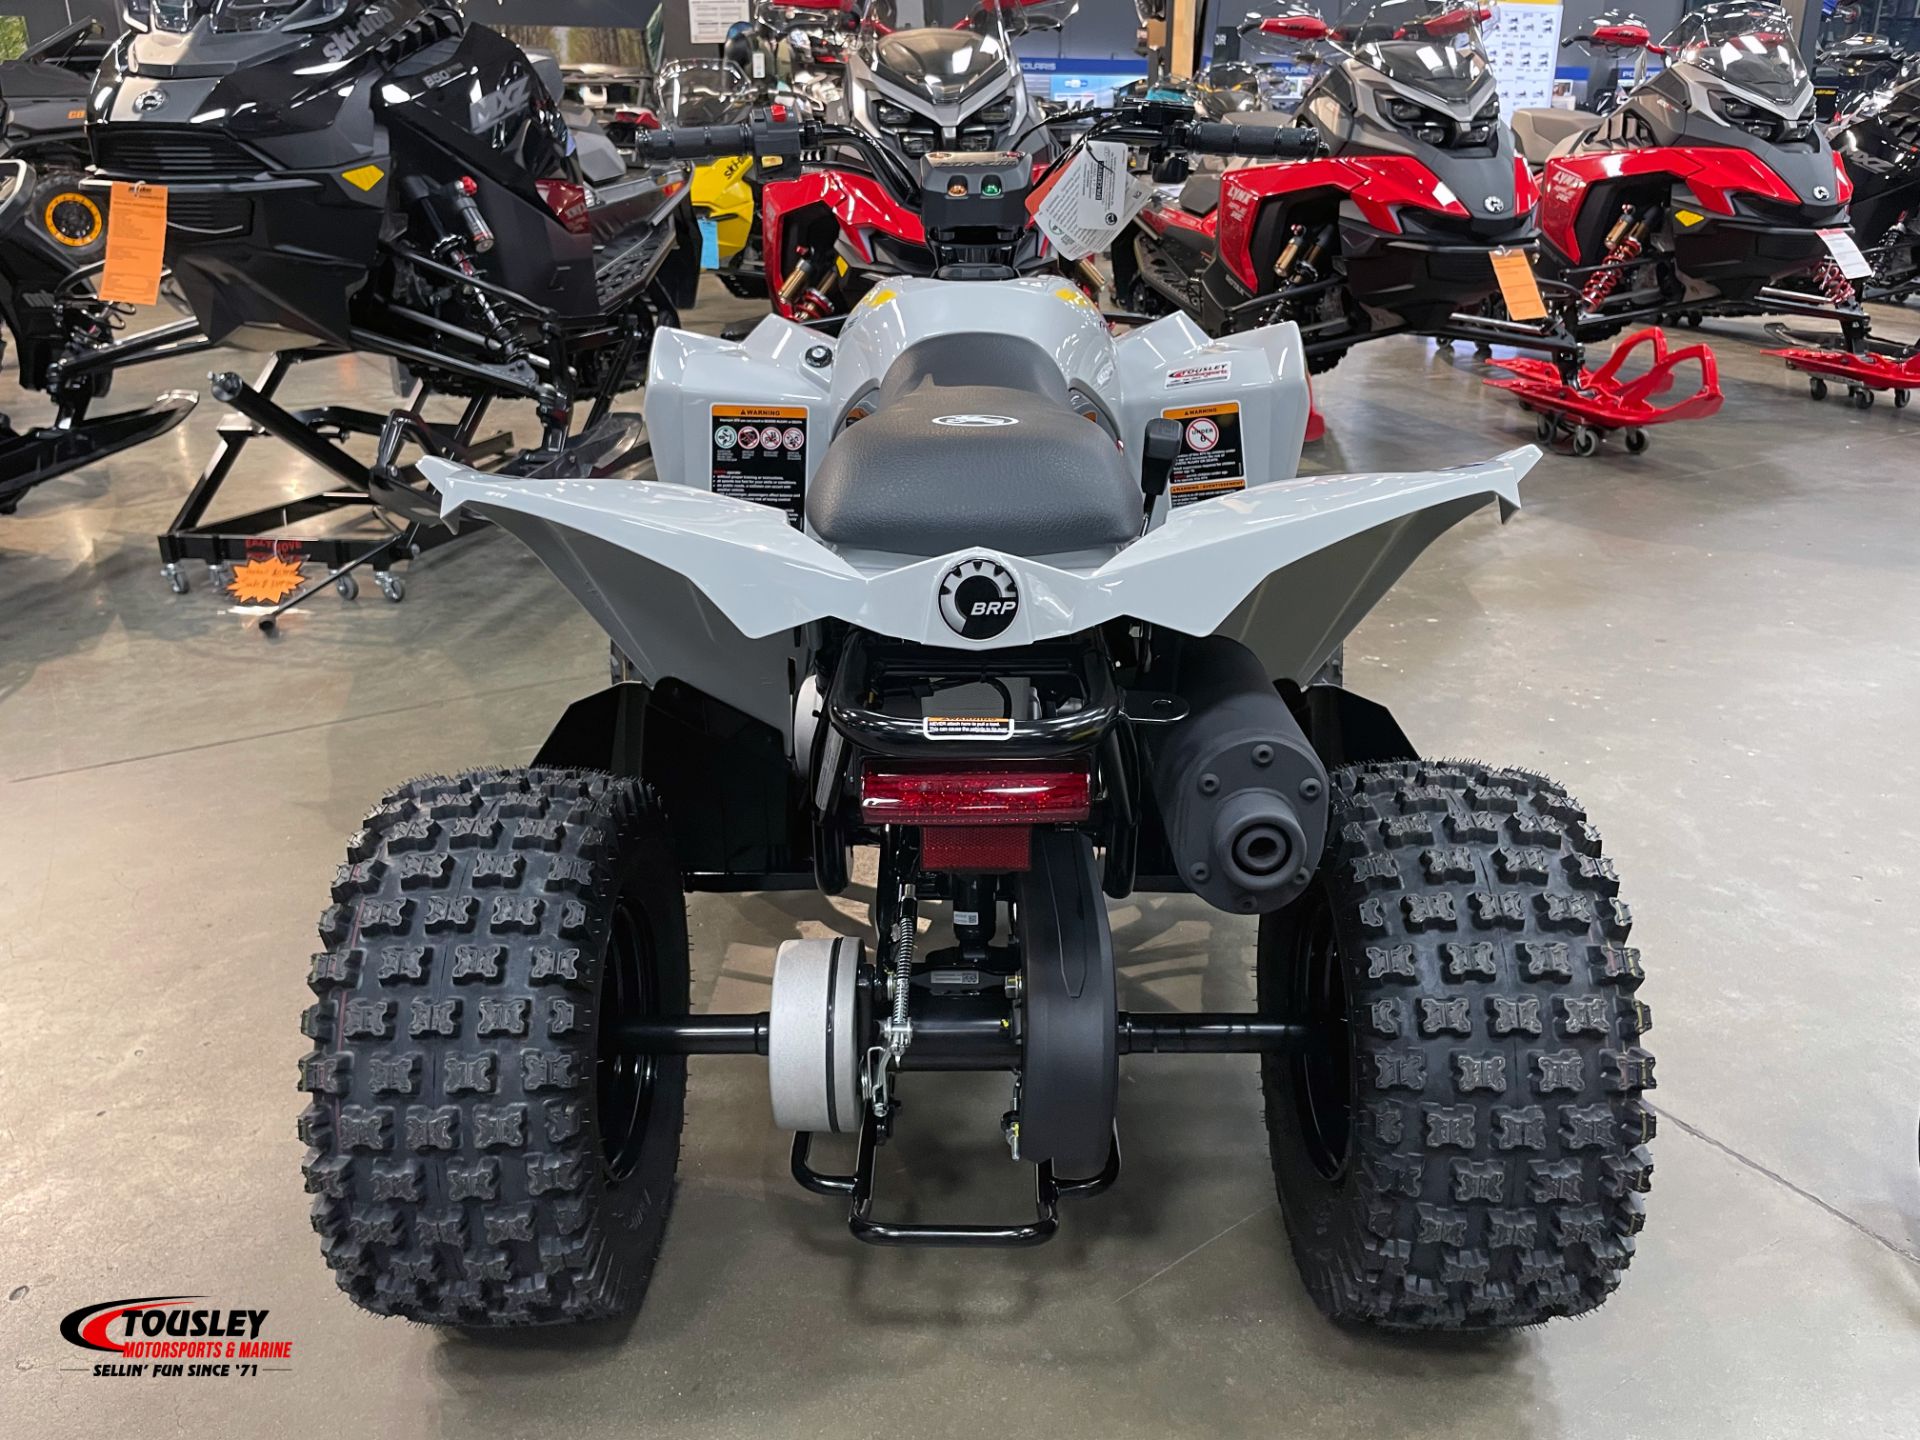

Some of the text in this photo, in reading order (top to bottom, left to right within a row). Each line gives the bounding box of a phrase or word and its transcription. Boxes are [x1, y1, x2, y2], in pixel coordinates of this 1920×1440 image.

[422, 69, 450, 89] 850
[1190, 407, 1217, 415] WARNING
[970, 601, 1016, 616] BRP
